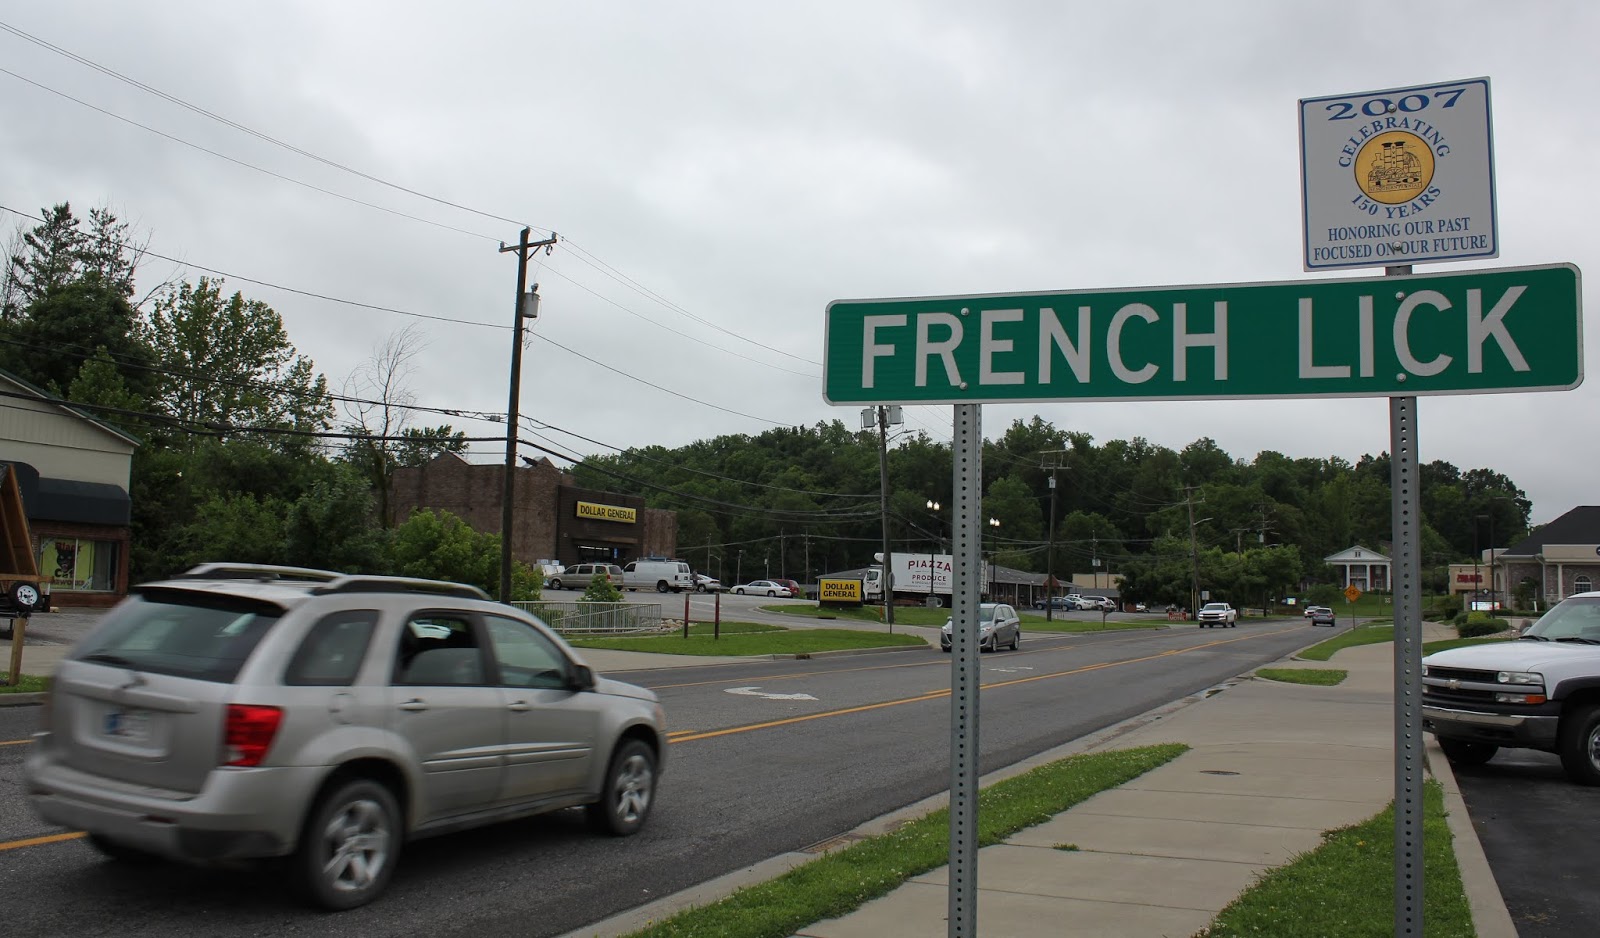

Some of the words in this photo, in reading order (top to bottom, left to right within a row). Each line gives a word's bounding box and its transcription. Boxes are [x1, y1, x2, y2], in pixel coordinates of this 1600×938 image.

[1326, 89, 1466, 121] 2007
[1338, 117, 1450, 168] CELEBRATING
[1352, 194, 1378, 215] 150
[1385, 185, 1441, 219] YEARS
[1328, 224, 1400, 241] HONORING
[1405, 220, 1434, 235] OUR
[1438, 217, 1470, 232] PAST
[1314, 245, 1372, 261] FOCUSED
[1376, 242, 1396, 257] ON
[1401, 239, 1429, 255] OUR
[1433, 235, 1488, 252] FUTURE
[861, 301, 1228, 389] FRENCH
[1298, 285, 1531, 379] LICK
[580, 505, 605, 516] DOLLAR
[607, 509, 634, 520] GENERAL
[908, 560, 952, 573] PIAZZA
[912, 574, 947, 582] PRODUCE
[823, 590, 858, 598] GENERAL
